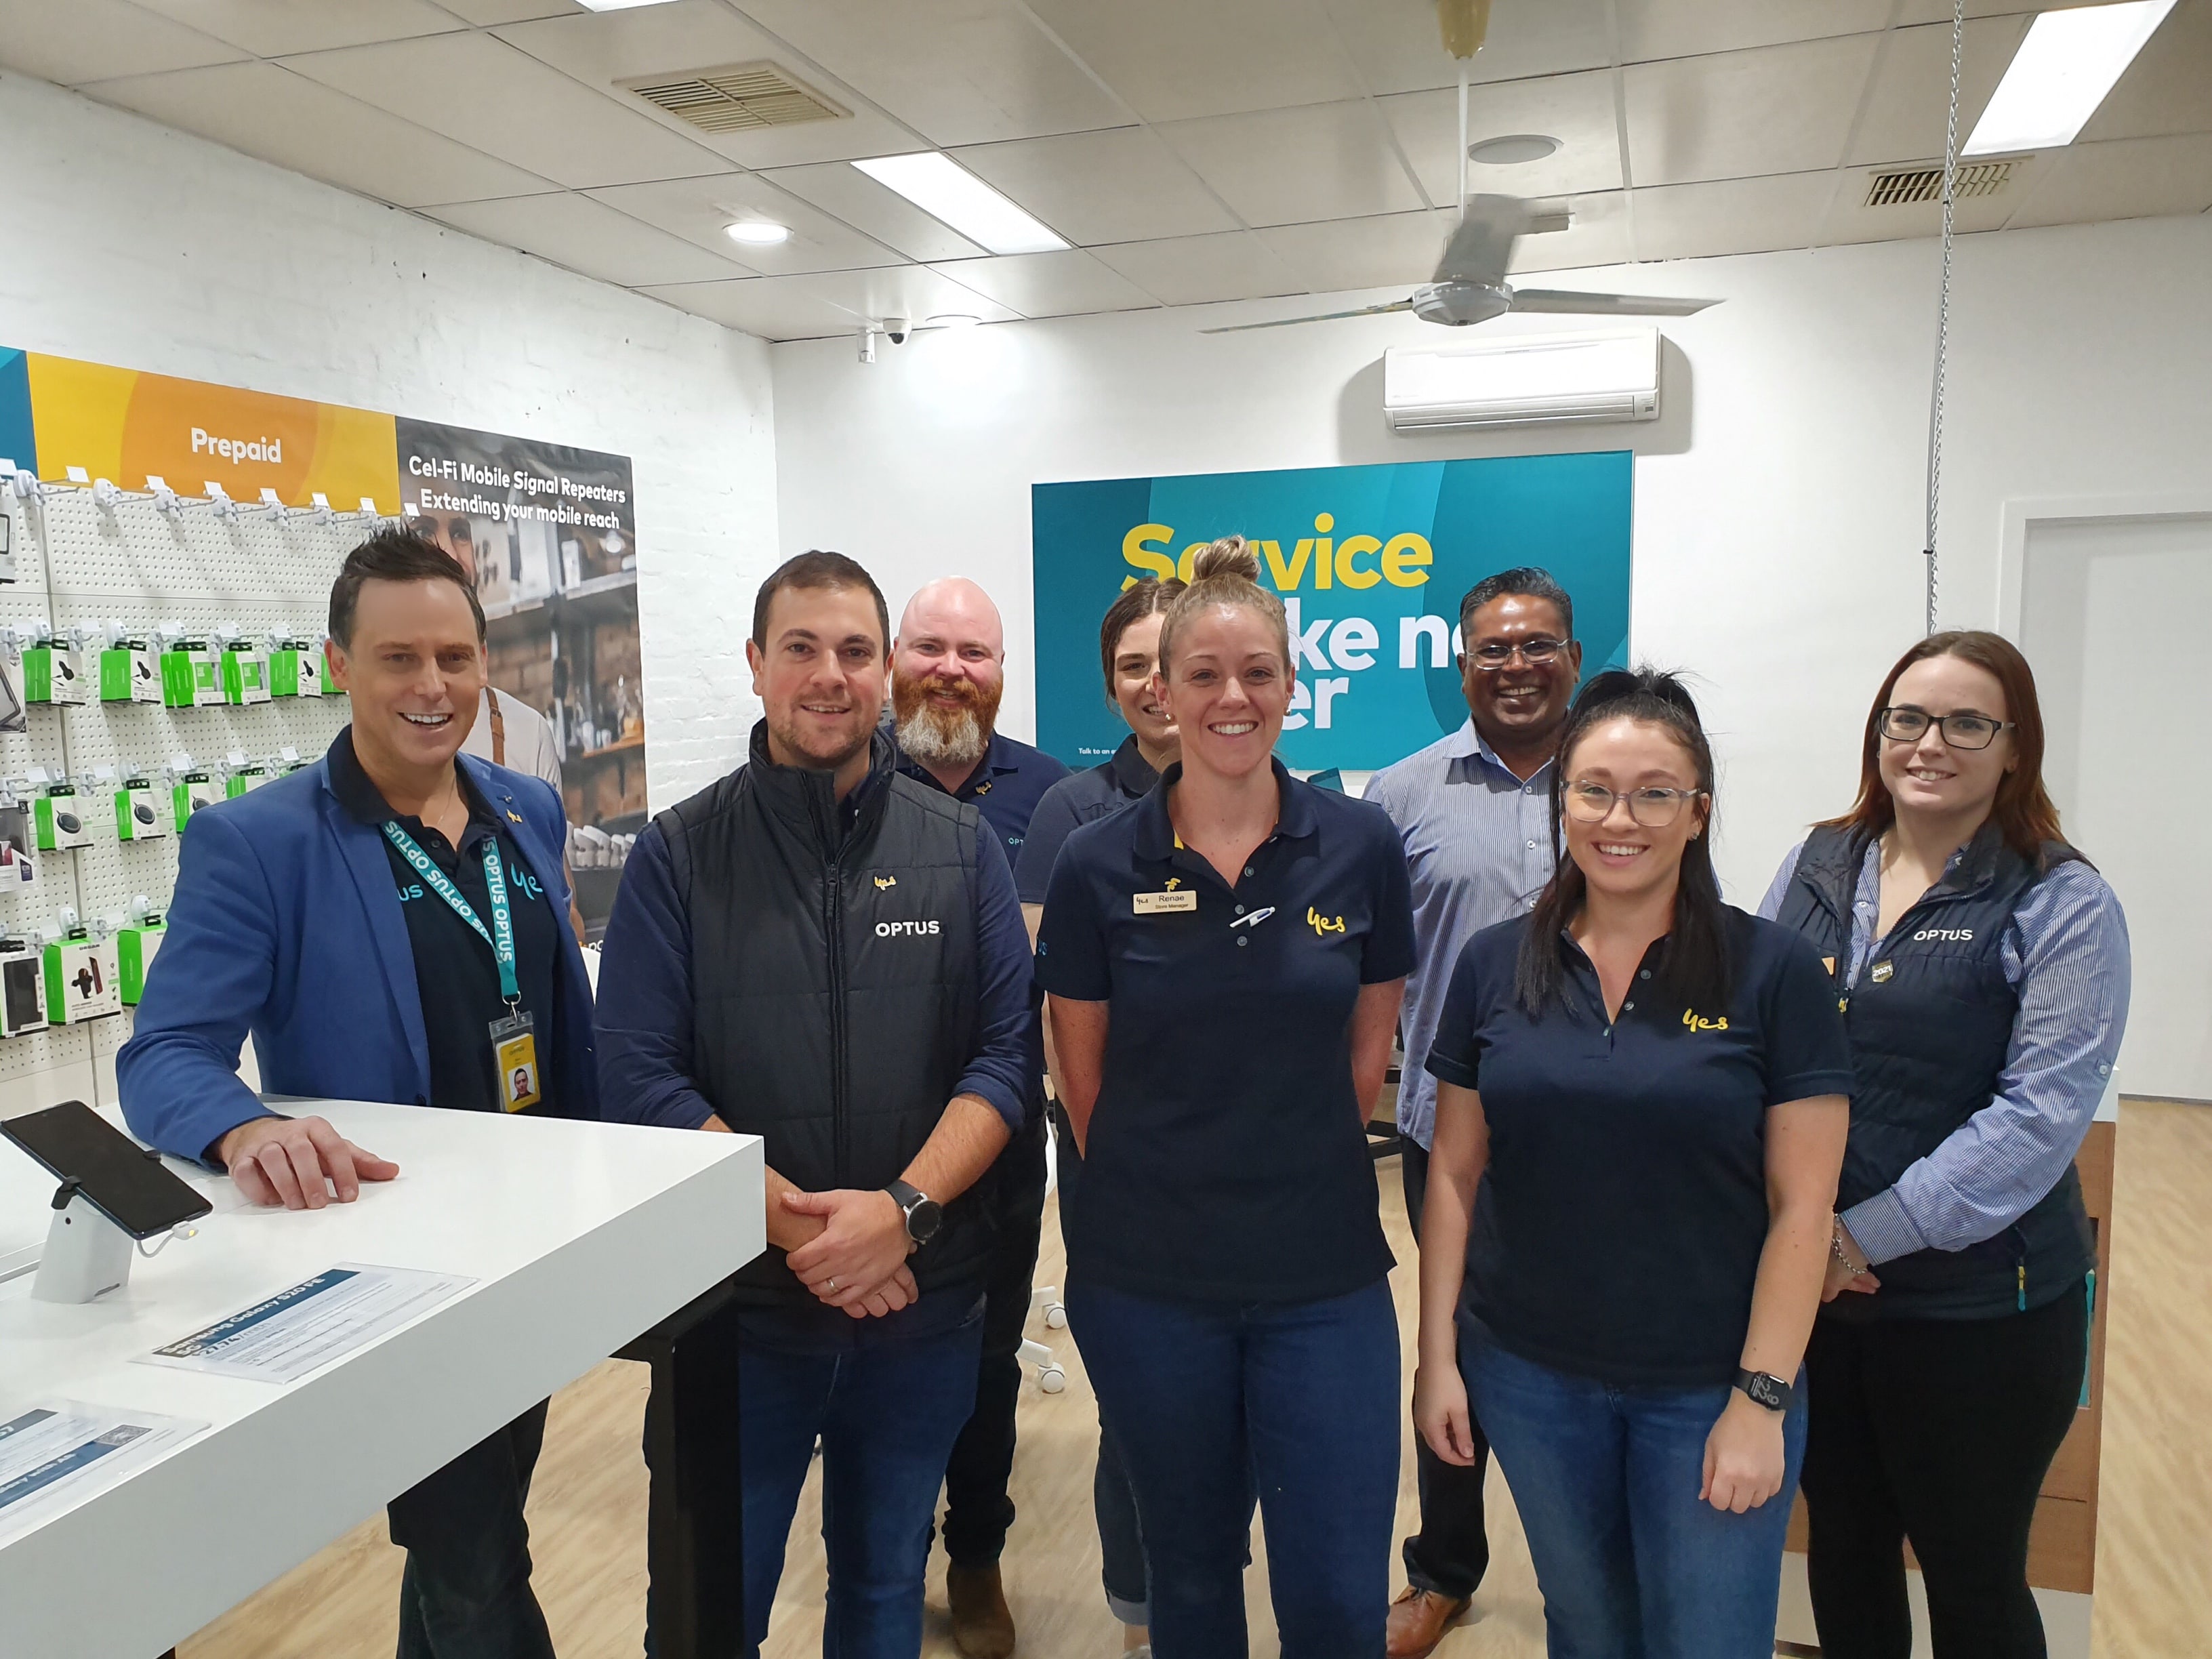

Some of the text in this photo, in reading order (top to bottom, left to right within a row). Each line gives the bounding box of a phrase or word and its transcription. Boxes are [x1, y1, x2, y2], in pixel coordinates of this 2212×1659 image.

[191, 427, 281, 464] Prepaid
[409, 455, 626, 503] Cel-Fi Mobile Signal Repeaters
[420, 488, 619, 529] Extending your mobile reach
[1120, 512, 1433, 592] Svice
[385, 821, 429, 869] OPTUS
[1008, 838, 1024, 846] OPT
[427, 869, 472, 917] OPTUS
[485, 855, 506, 905] OPTUS
[495, 909, 512, 962] OPTUS
[876, 920, 940, 937] OPTUS
[1914, 929, 1973, 941] OPTUS
[1873, 965, 1891, 977] 2021
[162, 1277, 325, 1353] Samsung Galaxy S20 FE
